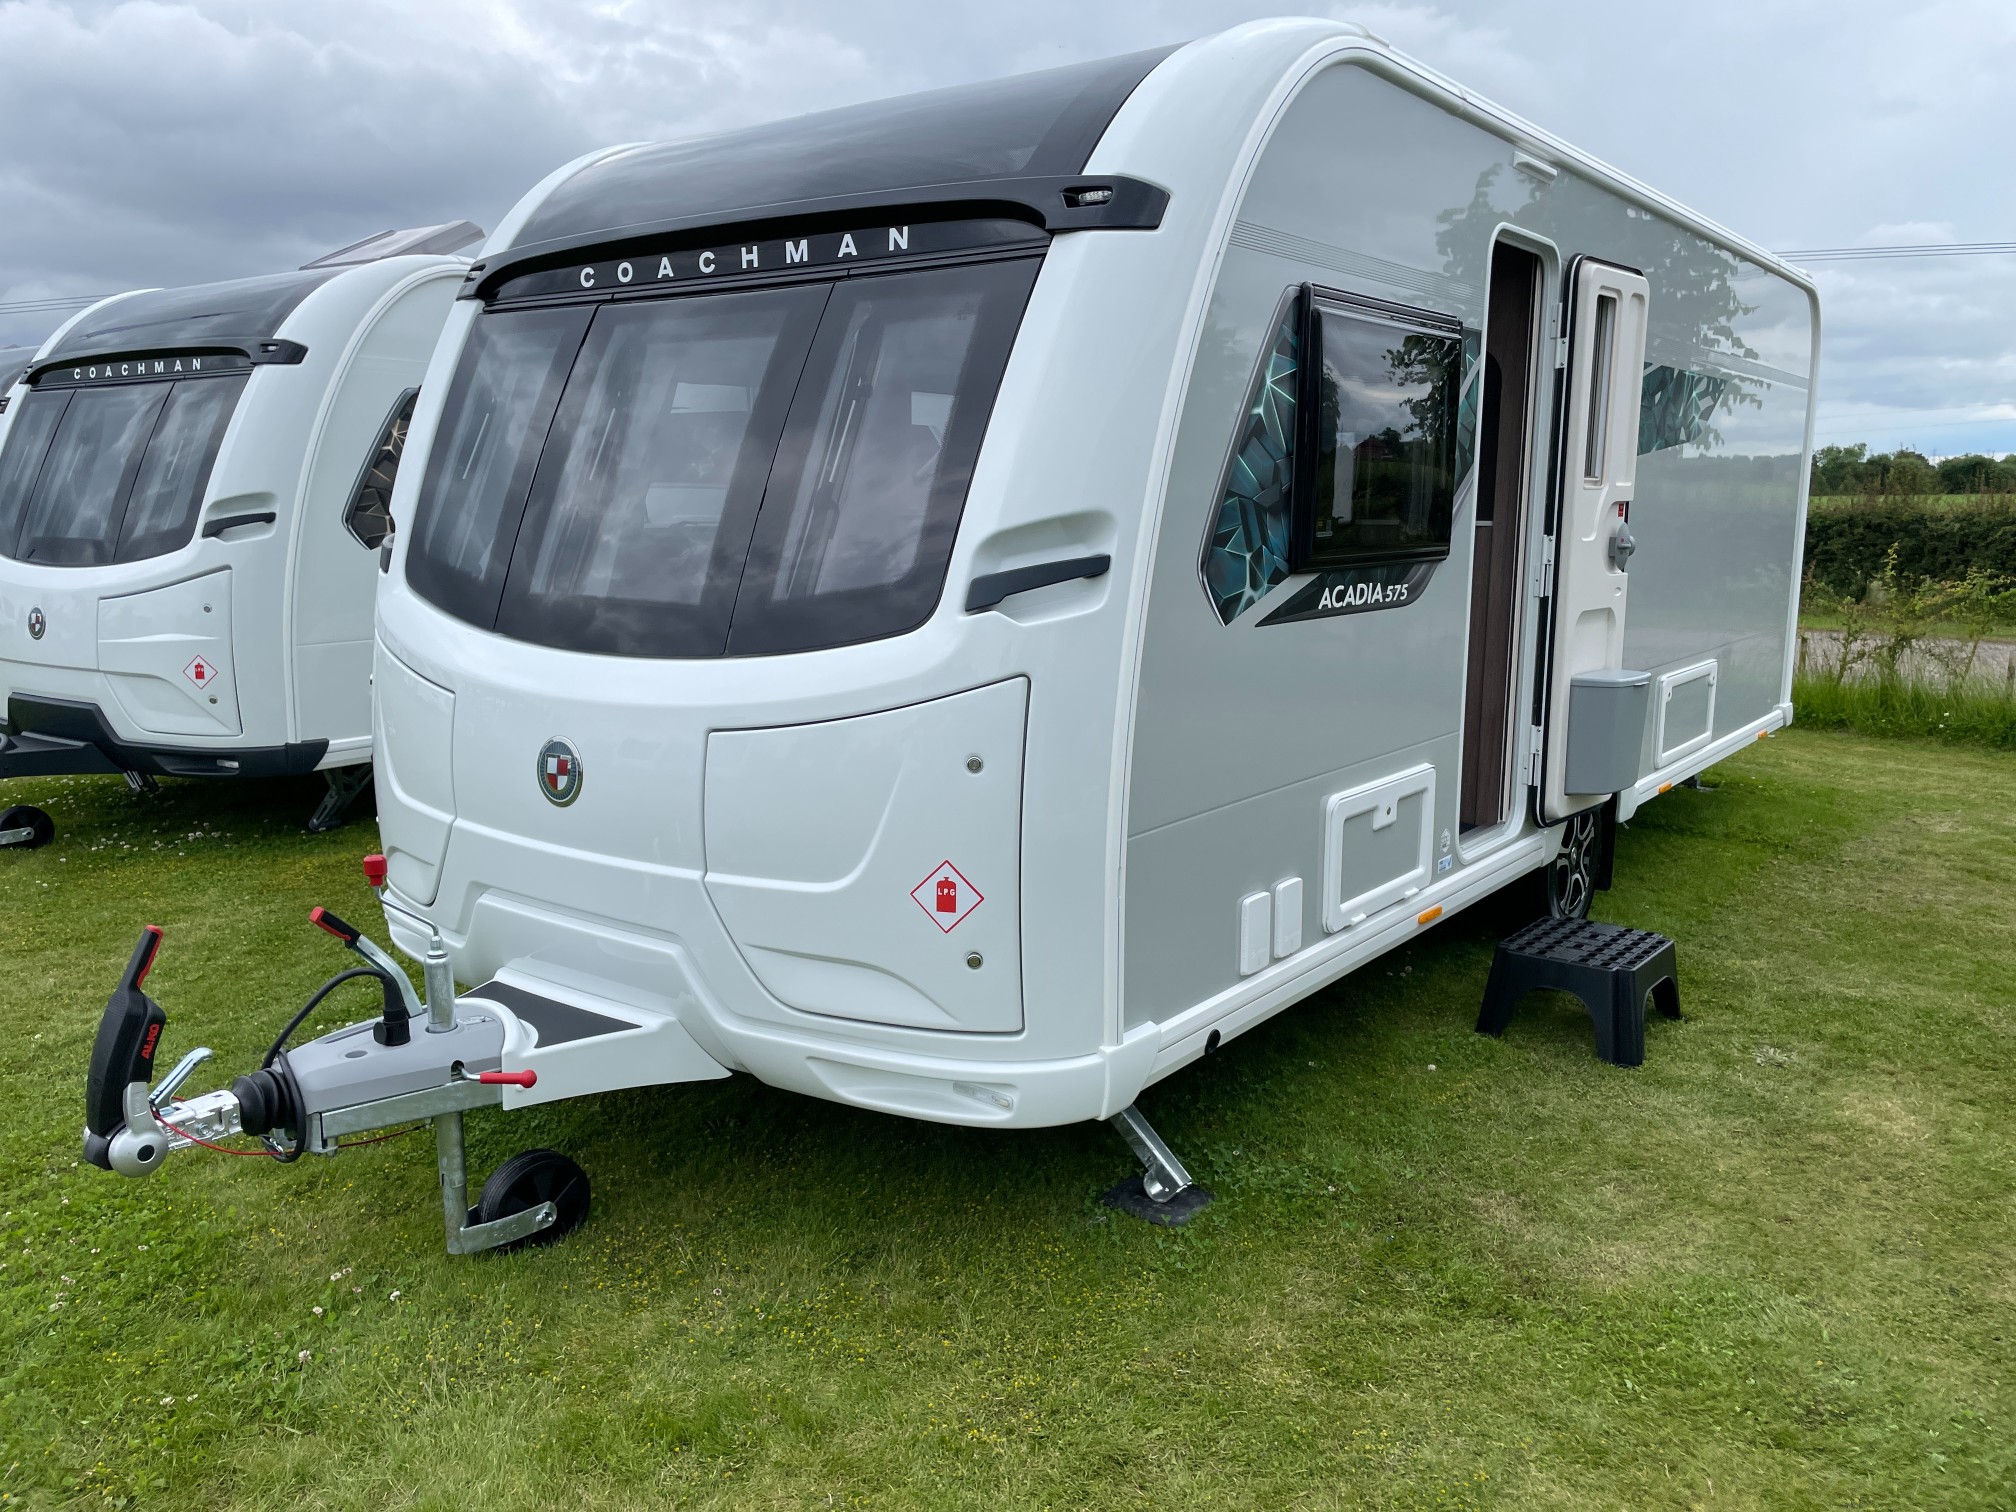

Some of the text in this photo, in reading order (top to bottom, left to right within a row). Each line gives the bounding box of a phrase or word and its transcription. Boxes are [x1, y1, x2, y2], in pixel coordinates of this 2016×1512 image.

[579, 225, 909, 288] COACHMAN
[73, 358, 201, 379] COACHMAN
[1318, 582, 1408, 609] ACADIA 575
[937, 887, 956, 896] LPG
